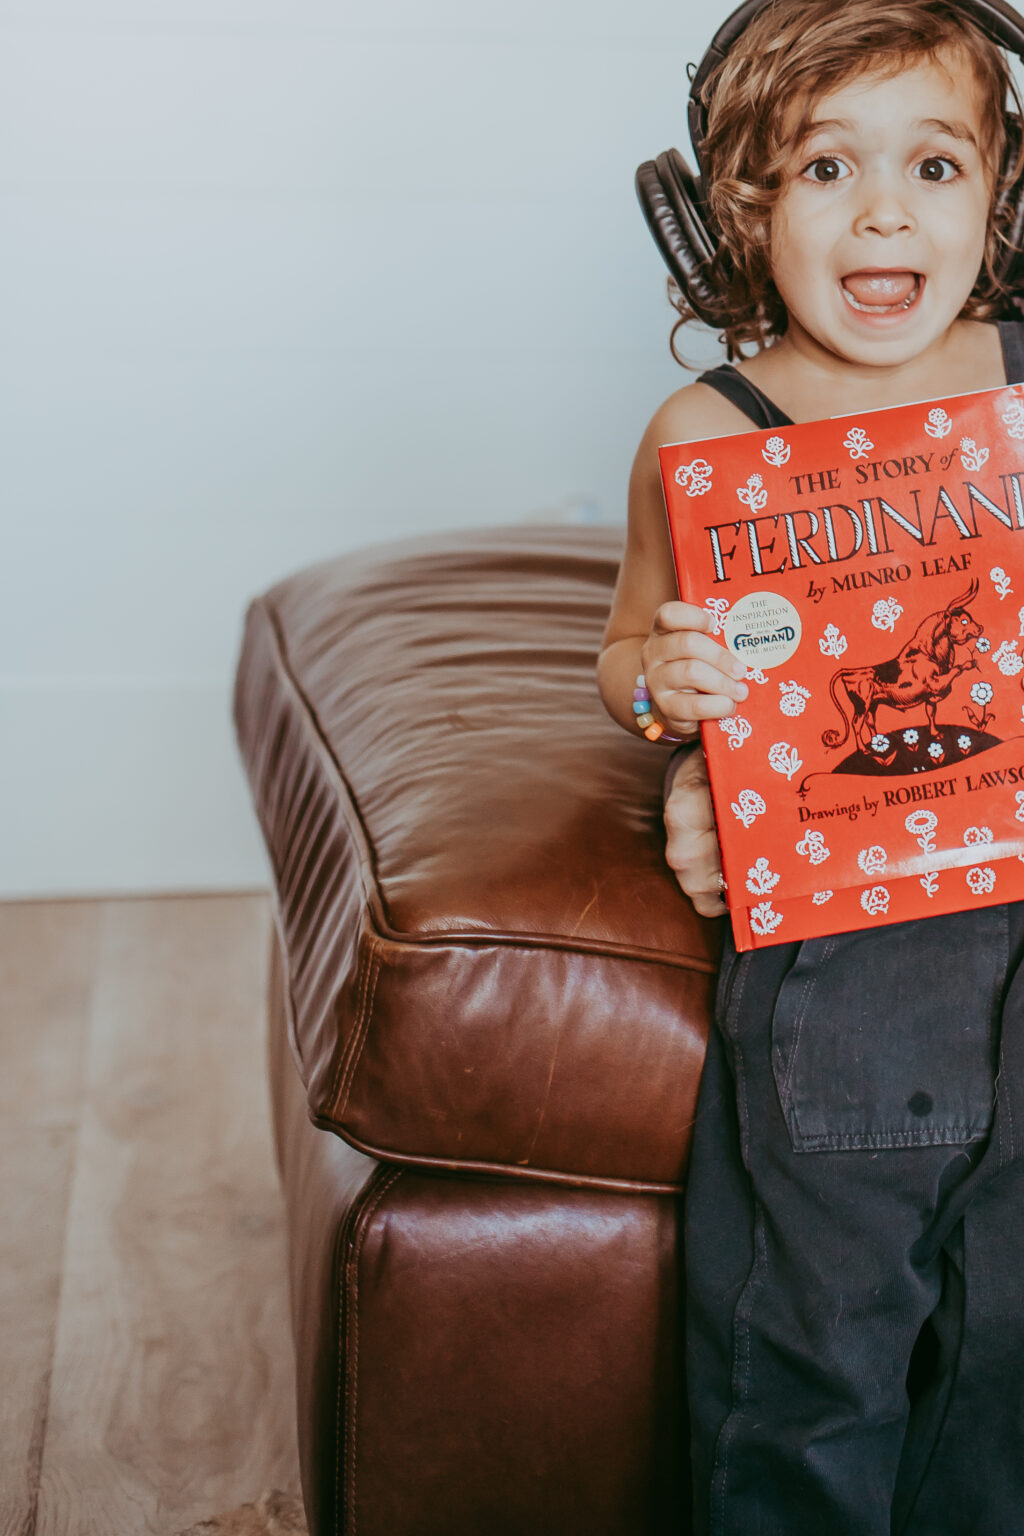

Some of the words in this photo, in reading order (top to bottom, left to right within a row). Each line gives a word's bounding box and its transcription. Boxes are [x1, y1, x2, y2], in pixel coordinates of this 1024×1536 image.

[788, 468, 842, 496] THE
[855, 452, 936, 485] STORY
[940, 447, 959, 471] of
[806, 580, 827, 603] by
[829, 563, 912, 594] MUNRO
[921, 552, 973, 578] LEAF
[732, 606, 789, 622] INSPIRATION
[751, 600, 768, 608] THE
[744, 618, 780, 631] BEHIND
[733, 625, 795, 651] FERDINAND
[763, 644, 786, 652] MOVIE
[797, 802, 862, 823] Drawings
[863, 795, 880, 816] by
[882, 777, 958, 807] ROBERT
